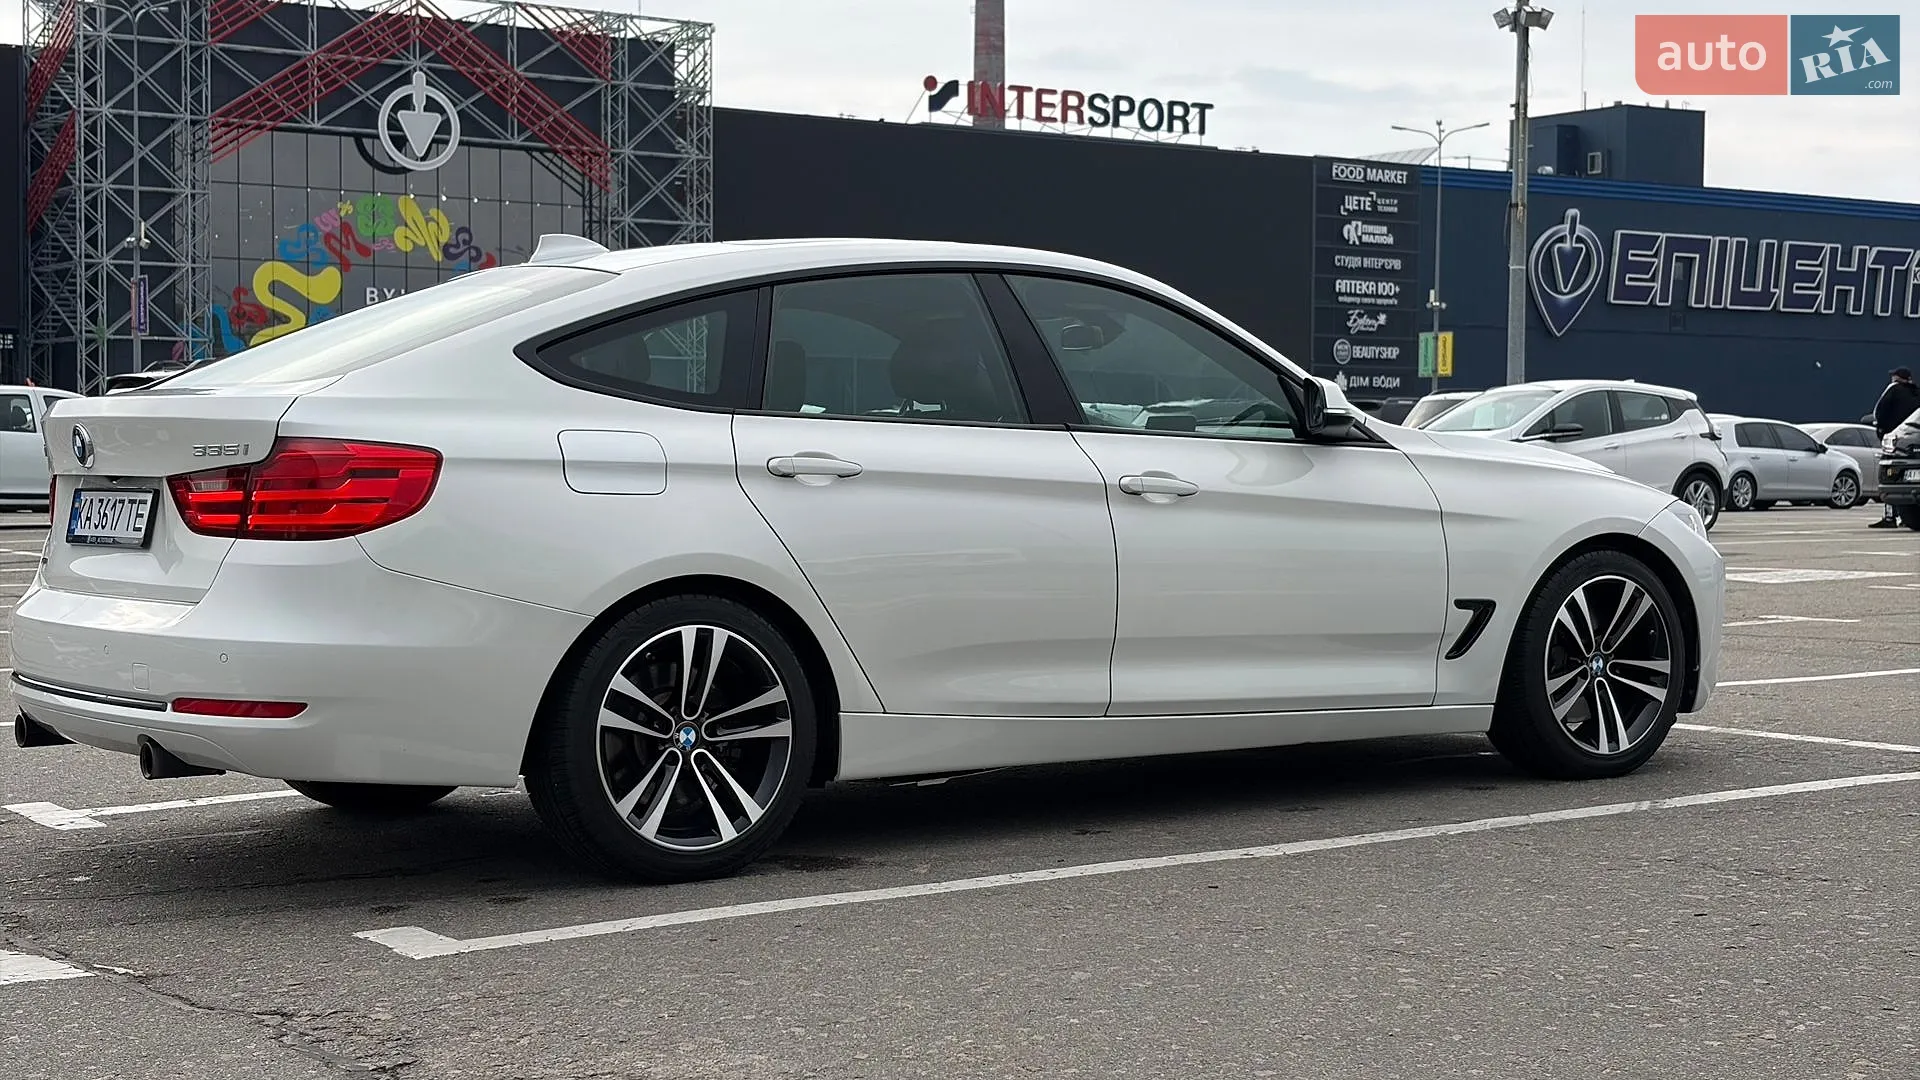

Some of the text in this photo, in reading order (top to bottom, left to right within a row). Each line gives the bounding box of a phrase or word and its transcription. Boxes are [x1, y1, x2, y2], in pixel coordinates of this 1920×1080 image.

[967, 80, 1215, 136] INTERSPORT
[1332, 165, 1408, 184] FOOD MARKET
[1344, 195, 1373, 212] ЦЕТЕ
[1335, 279, 1400, 296] АПТЕКА 100+
[1350, 375, 1400, 389] ДІМ ВОДИ
